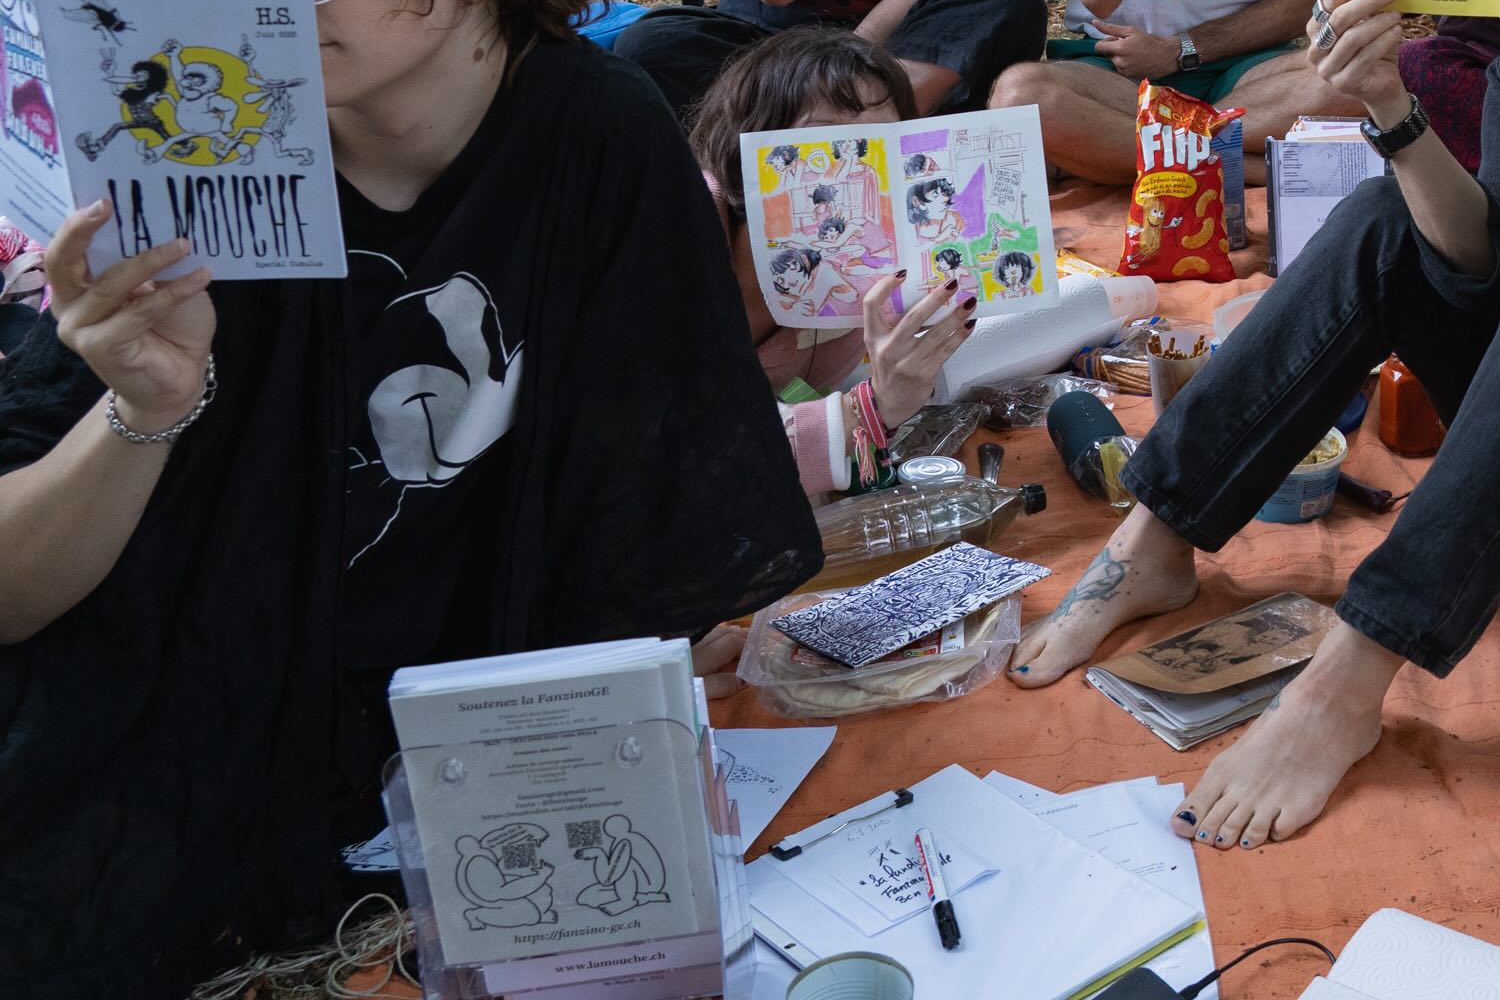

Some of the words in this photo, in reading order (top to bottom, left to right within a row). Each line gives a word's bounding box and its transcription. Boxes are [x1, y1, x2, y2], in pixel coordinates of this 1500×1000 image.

[255, 7, 296, 26] H.S.
[108, 178, 153, 259] LA
[167, 174, 312, 259] MOUCHE
[458, 698, 518, 712] Soutenez
[521, 695, 534, 706] la
[538, 686, 611, 704] FanzinoGE
[513, 919, 641, 944] https://fanzino-ge.ch
[554, 951, 667, 973] www.lamouche.ch
